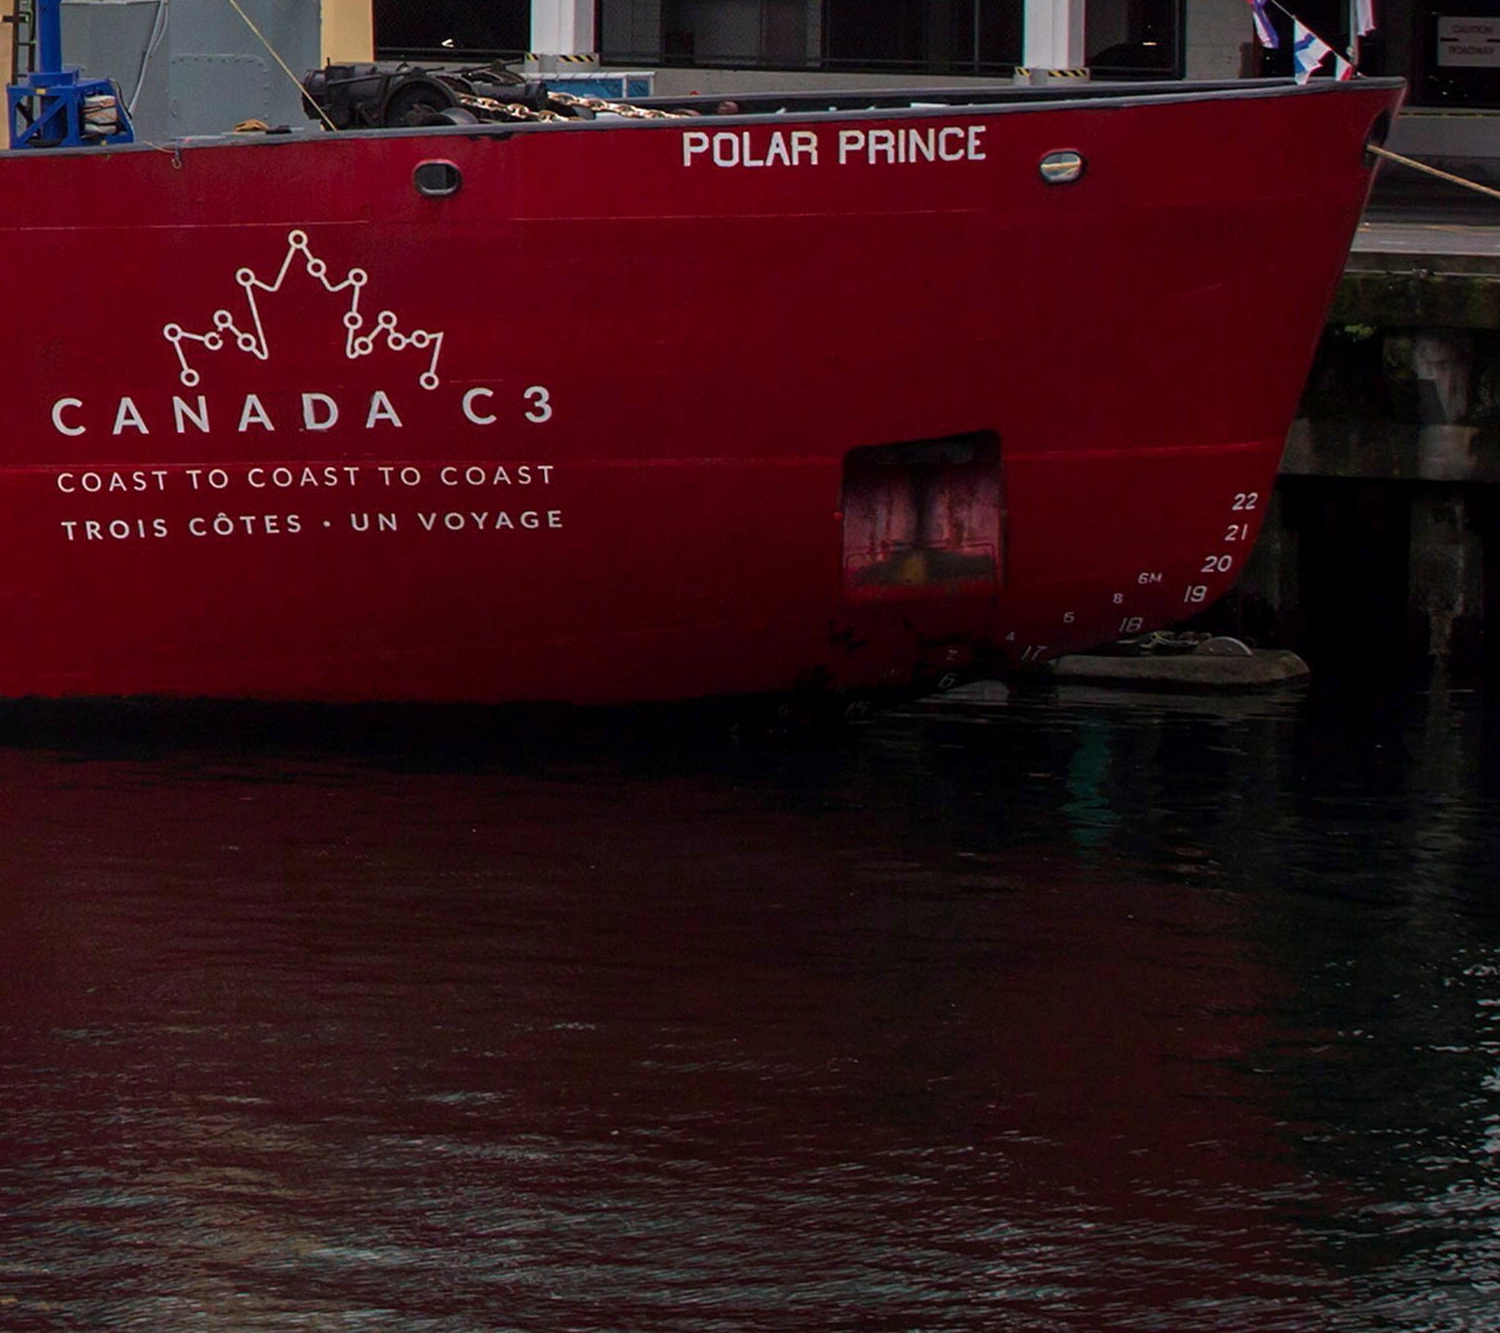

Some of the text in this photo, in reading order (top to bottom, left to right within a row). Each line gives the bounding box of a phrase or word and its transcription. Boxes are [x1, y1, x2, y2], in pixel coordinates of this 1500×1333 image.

[682, 125, 988, 168] POLAR PRINCE
[51, 385, 554, 436] CANADA C3
[57, 464, 555, 493] COAST TO COAST TO COAST
[1231, 492, 1259, 511] 22
[60, 510, 564, 541] TROIS CÔTES UN VOYAGE
[1224, 523, 1248, 541] 21
[1200, 555, 1233, 573] 20
[1137, 572, 1162, 584] 6M
[1183, 585, 1208, 603] 19
[1118, 616, 1144, 633] 18
